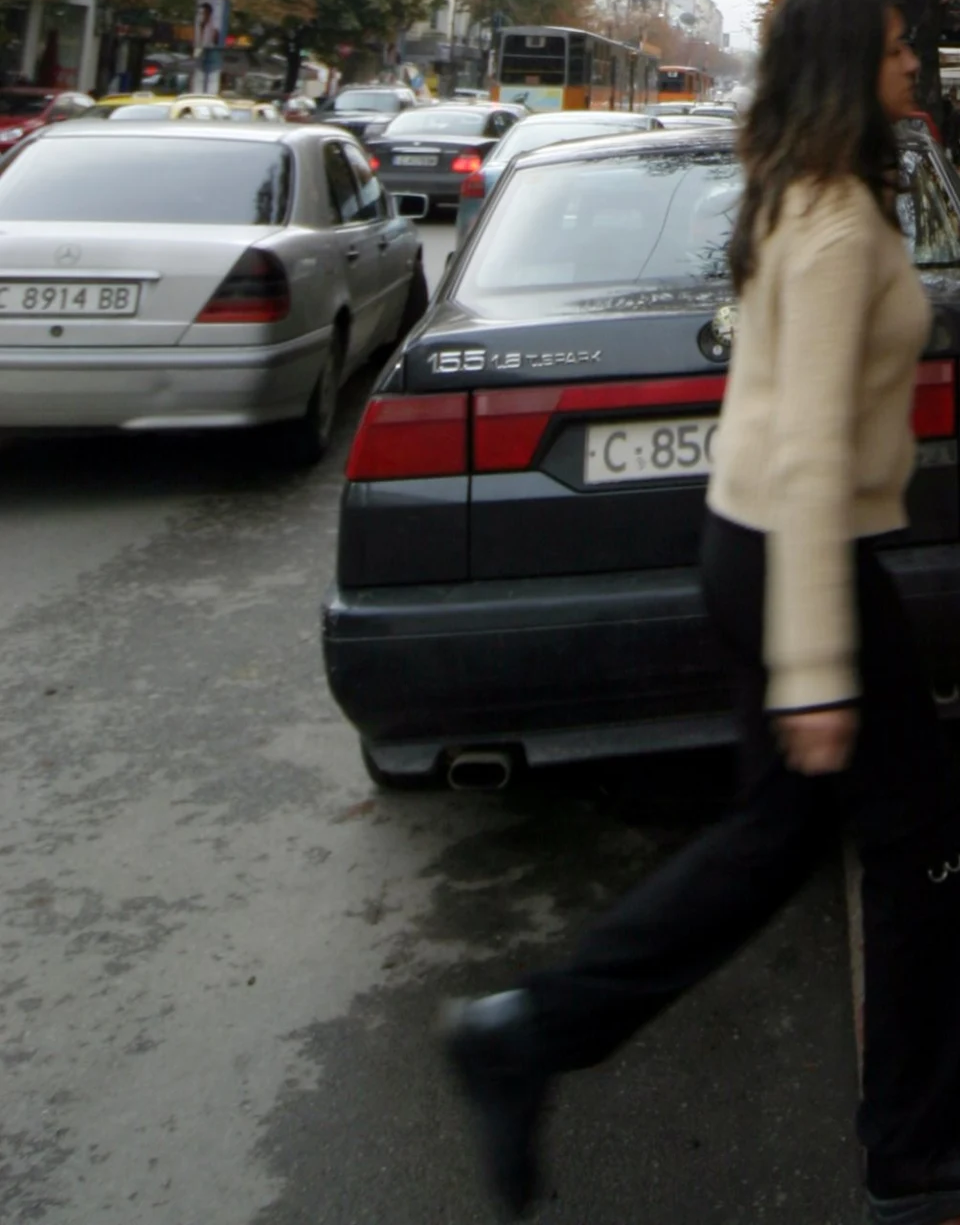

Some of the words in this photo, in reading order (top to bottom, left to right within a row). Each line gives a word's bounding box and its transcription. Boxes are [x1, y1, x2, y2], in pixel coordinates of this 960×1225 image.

[21, 286, 87, 311] 8914
[98, 286, 131, 311] BB
[428, 349, 487, 374] 155
[603, 431, 627, 472] C
